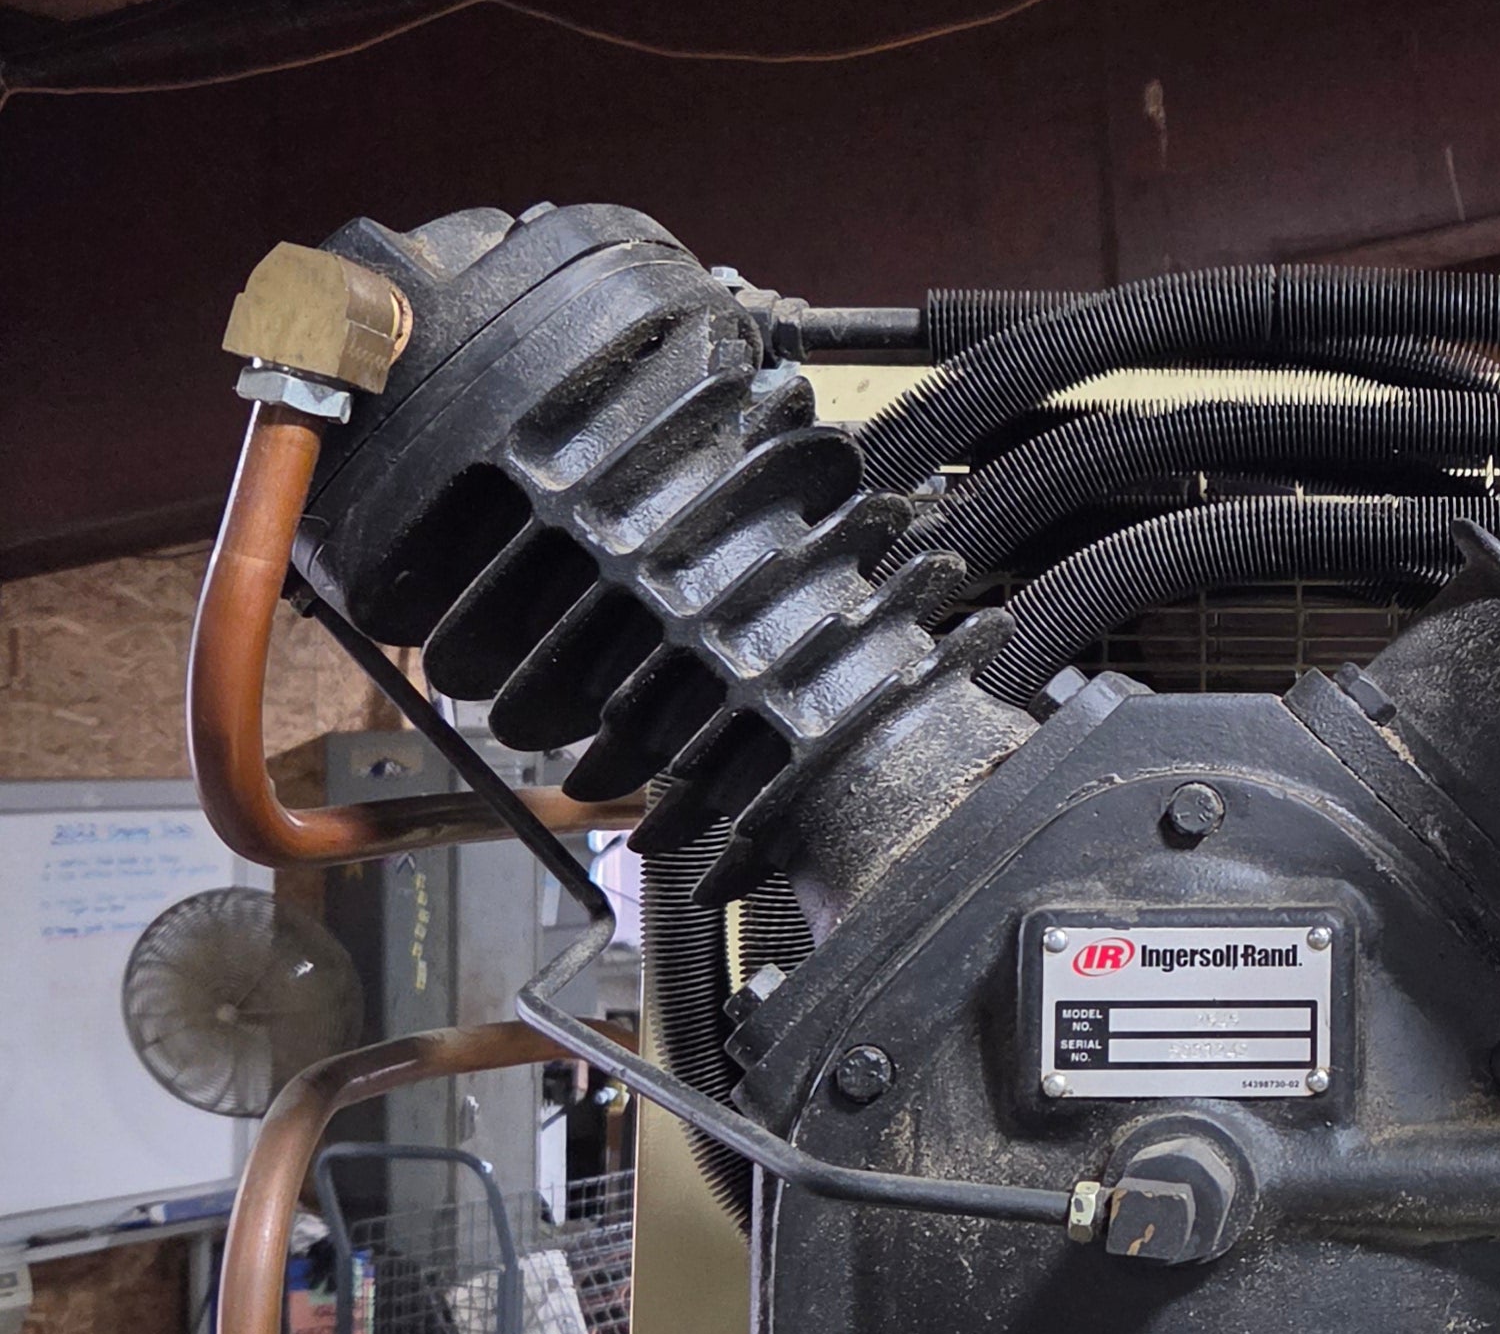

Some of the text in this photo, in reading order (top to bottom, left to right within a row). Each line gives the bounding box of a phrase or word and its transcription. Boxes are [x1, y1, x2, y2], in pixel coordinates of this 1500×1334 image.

[1080, 942, 1128, 971] IR
[1062, 1009, 1103, 1019] MODEL
[1072, 1022, 1092, 1031] NO.
[1060, 1040, 1102, 1050] SERIAL
[1071, 1052, 1091, 1062] NO.
